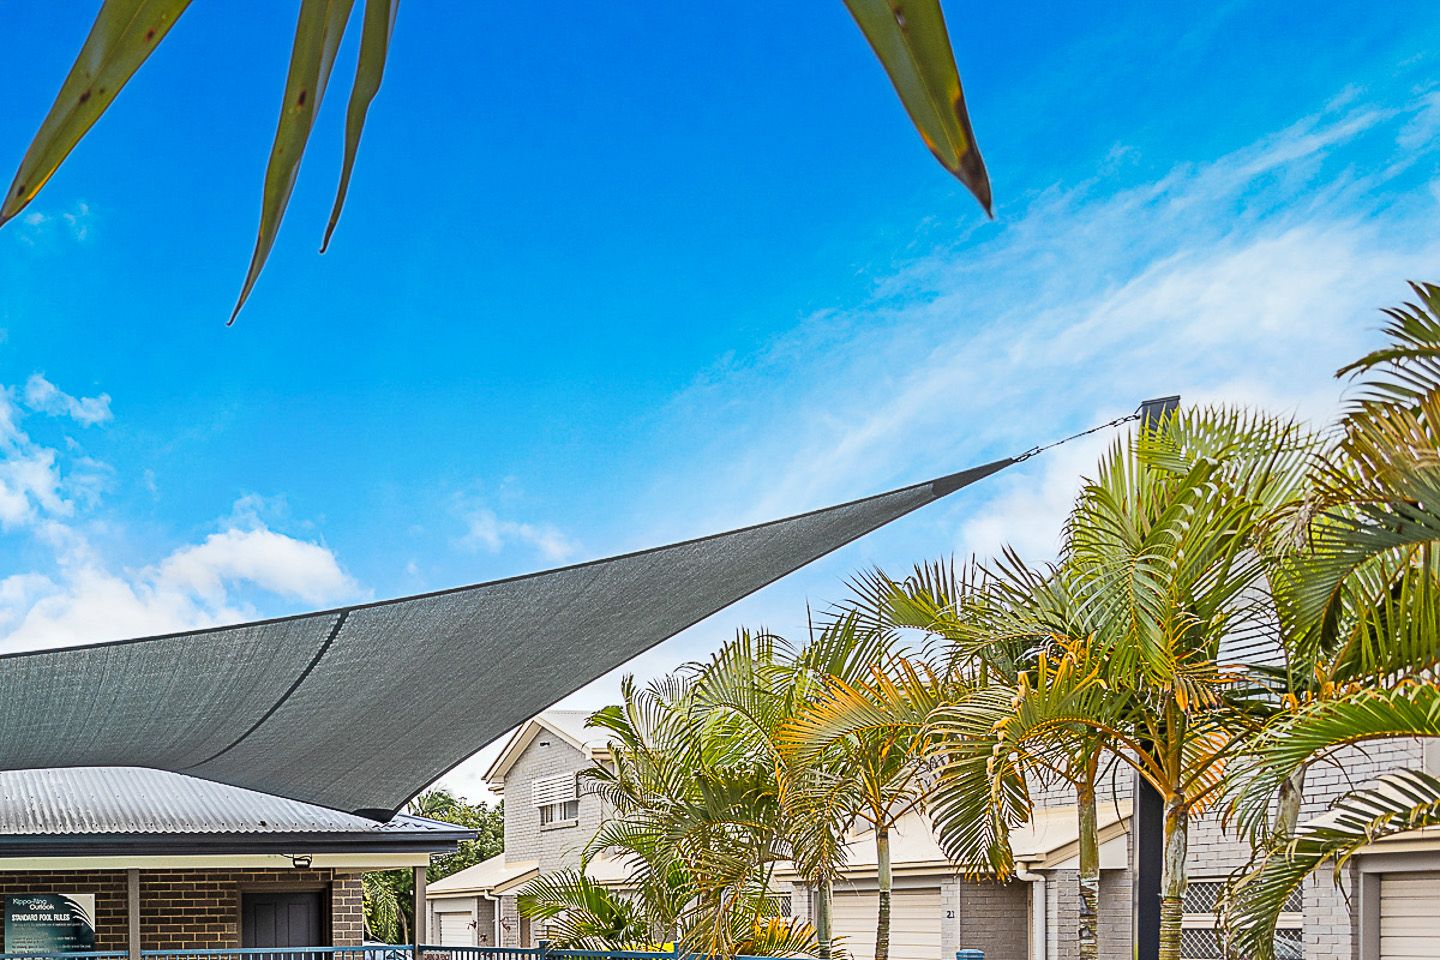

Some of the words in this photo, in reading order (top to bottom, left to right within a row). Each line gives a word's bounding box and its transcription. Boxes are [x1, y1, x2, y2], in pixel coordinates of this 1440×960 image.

[11, 913, 38, 922] STANDARD
[39, 913, 53, 921] POOL
[53, 913, 71, 921] RULES
